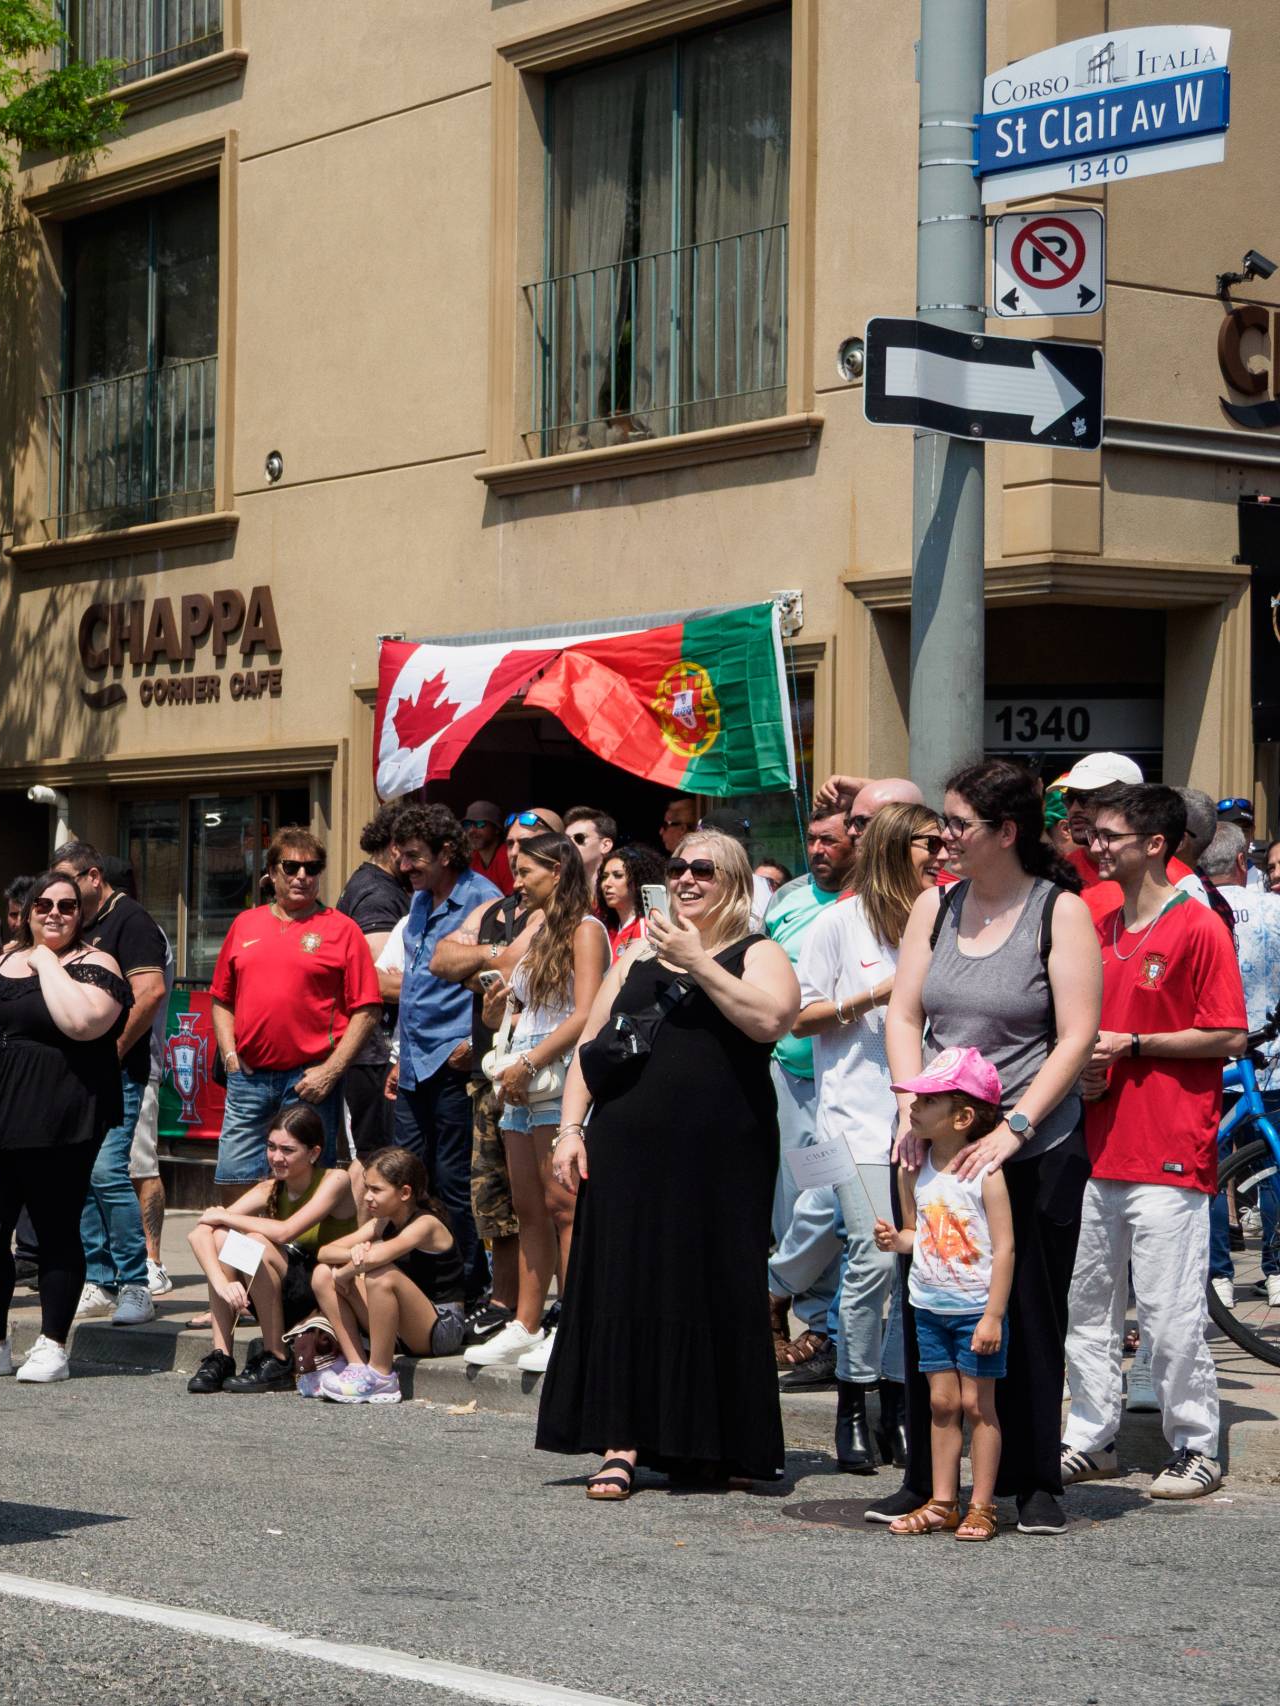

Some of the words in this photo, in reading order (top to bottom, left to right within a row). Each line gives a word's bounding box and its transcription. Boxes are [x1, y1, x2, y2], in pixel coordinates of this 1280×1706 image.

[991, 75, 1069, 106] CORSO
[1135, 45, 1217, 77] ITALIA
[995, 117, 1027, 158] St
[1039, 98, 1122, 149] Clair
[1131, 100, 1166, 133] Av
[1175, 79, 1204, 124] W
[1068, 154, 1128, 184] 1340
[78, 585, 283, 671] CHAPPA
[139, 674, 221, 707] CORNER
[229, 668, 283, 701] CAFE
[995, 706, 1090, 742] 1340
